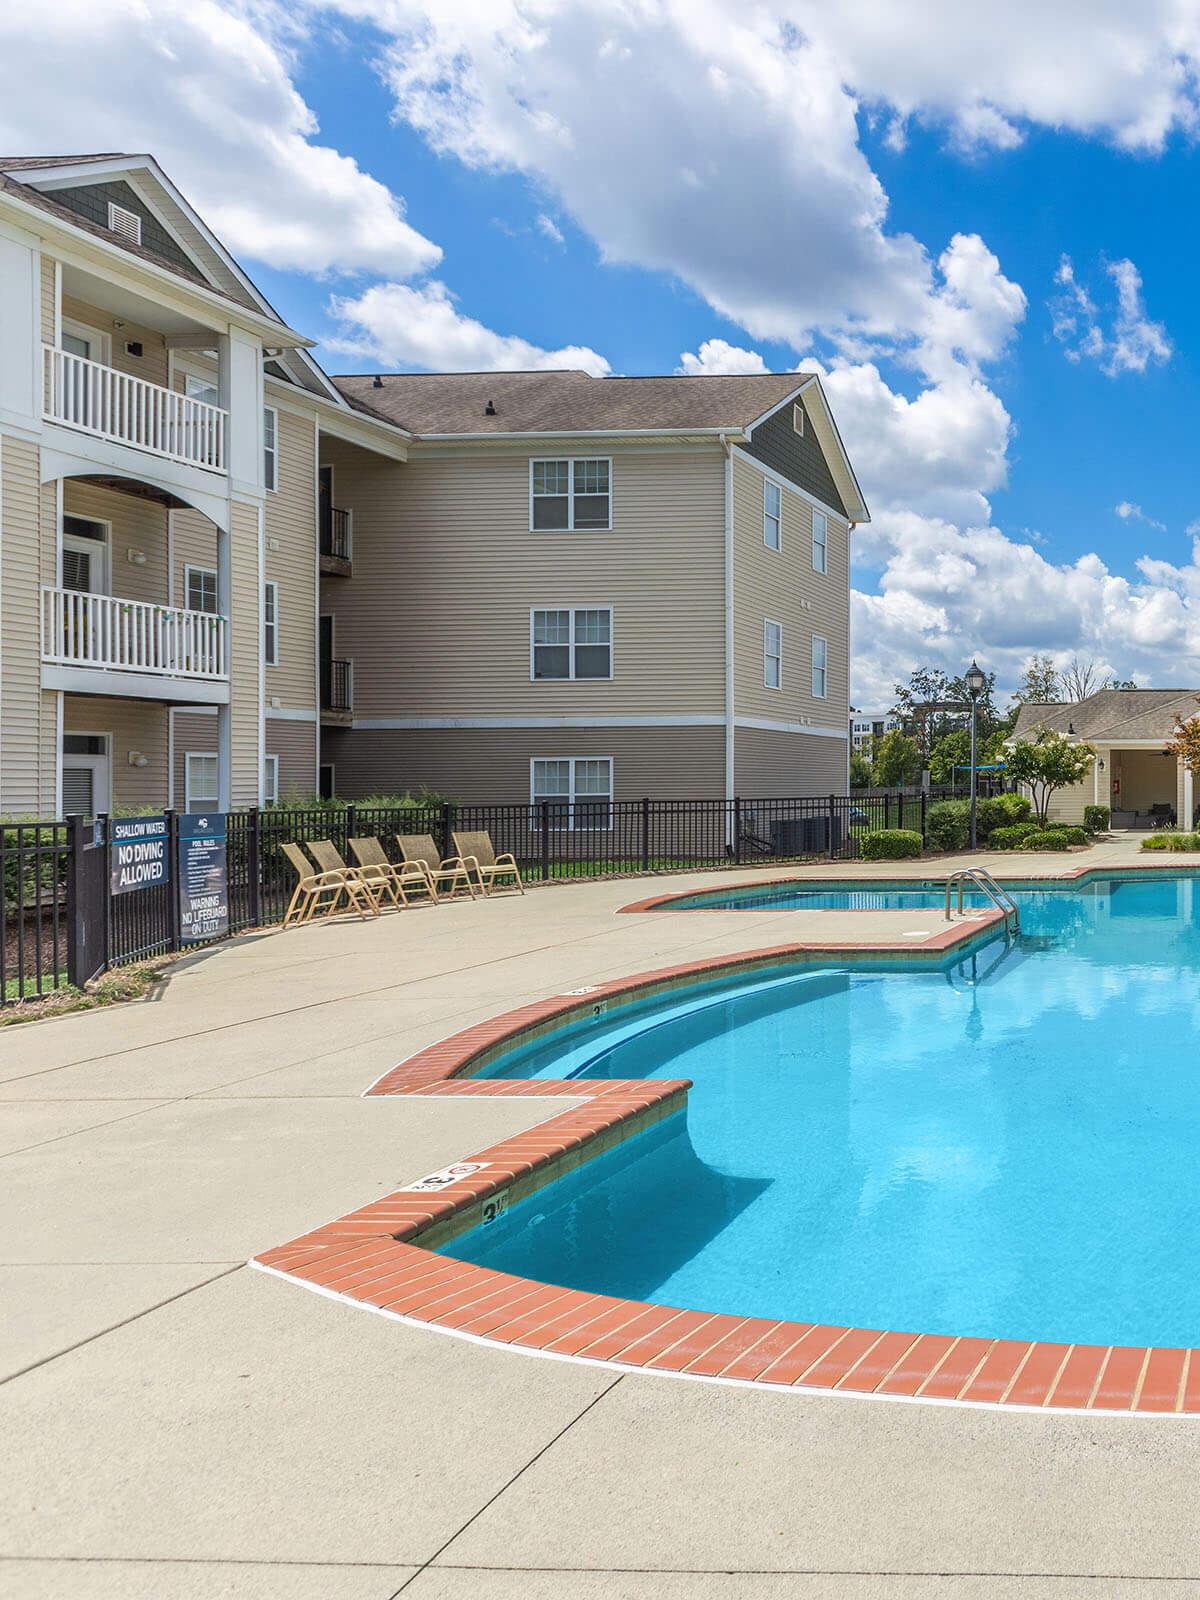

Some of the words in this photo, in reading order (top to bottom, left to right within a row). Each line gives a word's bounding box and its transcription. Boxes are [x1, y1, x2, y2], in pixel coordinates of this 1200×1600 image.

[115, 823, 145, 839] SHALLOW
[145, 821, 165, 834] WATER
[118, 846, 134, 865] NO
[135, 842, 163, 861] DIVING
[119, 863, 163, 886] ALLOWED
[190, 896, 219, 910] WARNING
[182, 912, 192, 925] NO
[194, 906, 228, 922] LIFEGUARD
[192, 921, 202, 935] ON
[203, 919, 220, 932] DUTY
